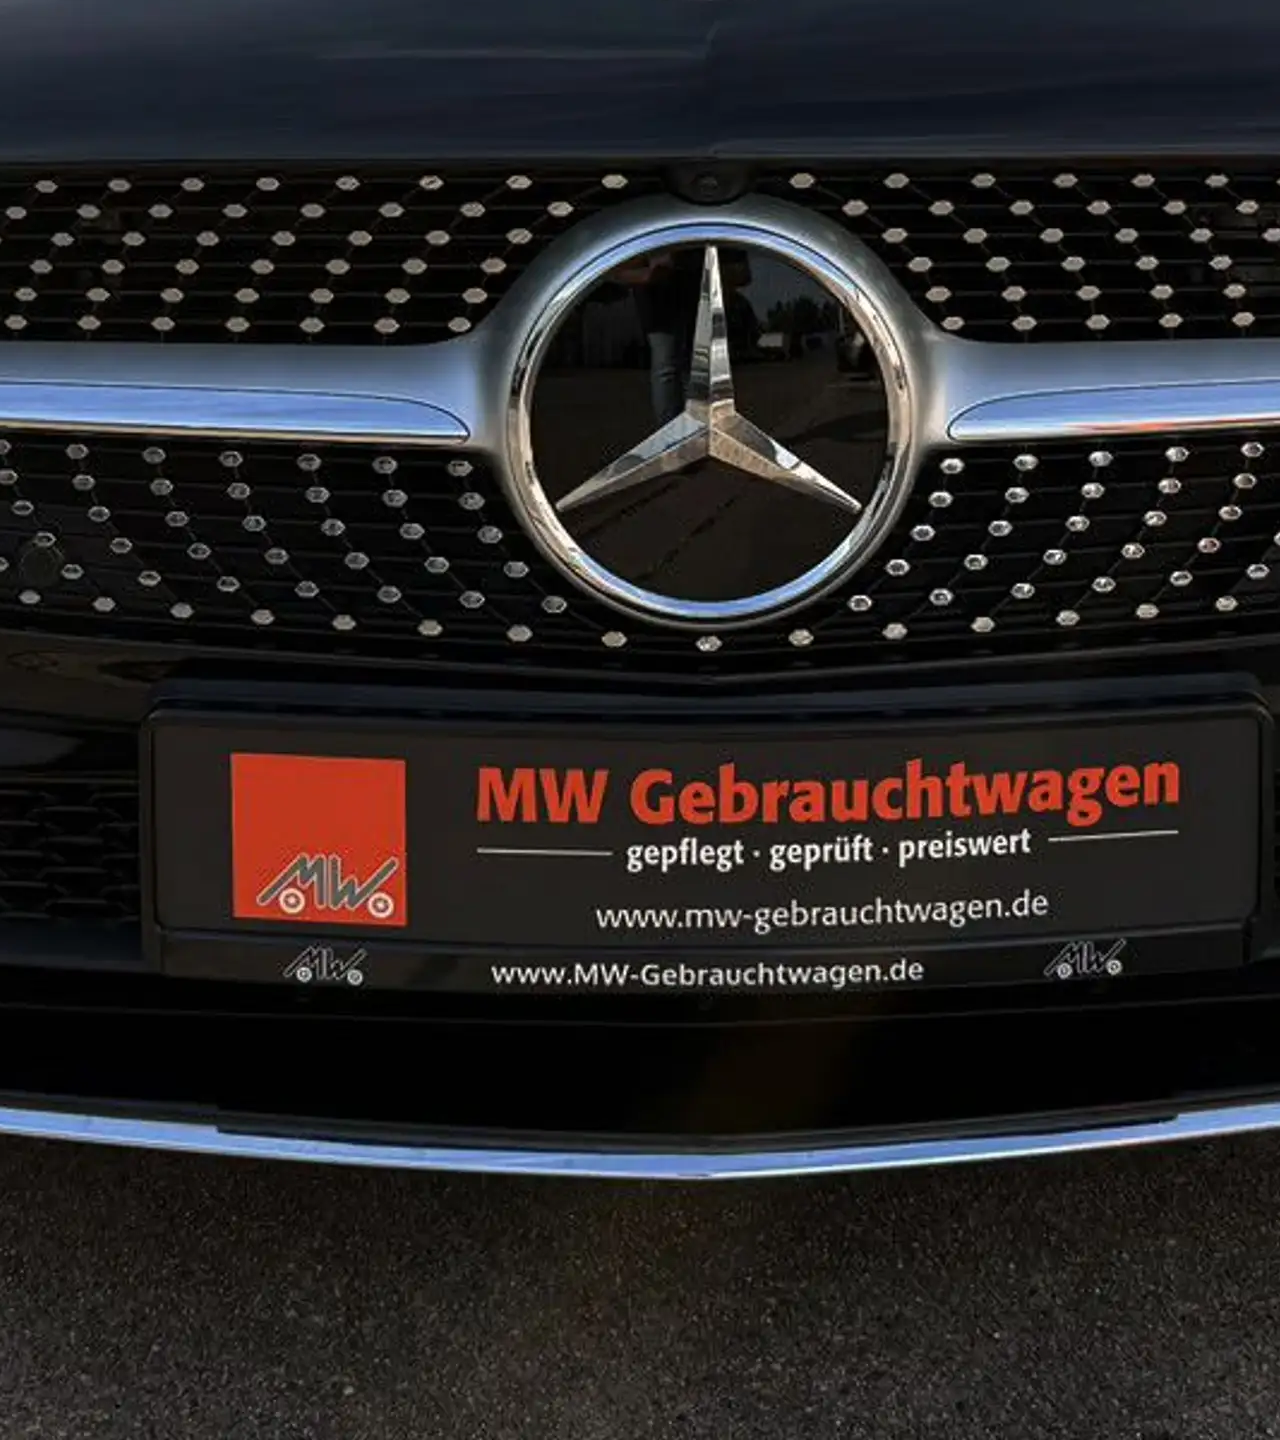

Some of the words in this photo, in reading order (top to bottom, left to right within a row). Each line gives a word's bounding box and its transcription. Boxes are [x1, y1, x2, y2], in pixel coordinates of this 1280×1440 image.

[476, 766, 608, 823] MW
[629, 758, 1180, 827] Gebrauchtwagen
[626, 837, 745, 872] gepflegt
[769, 834, 874, 871] geprüft
[899, 827, 1032, 868] preiswert
[256, 853, 400, 918] MW
[595, 888, 1049, 936] www.mw-gebrauchtwagen.de
[490, 957, 925, 990] www.MW-Gebrauchtwagen.de
